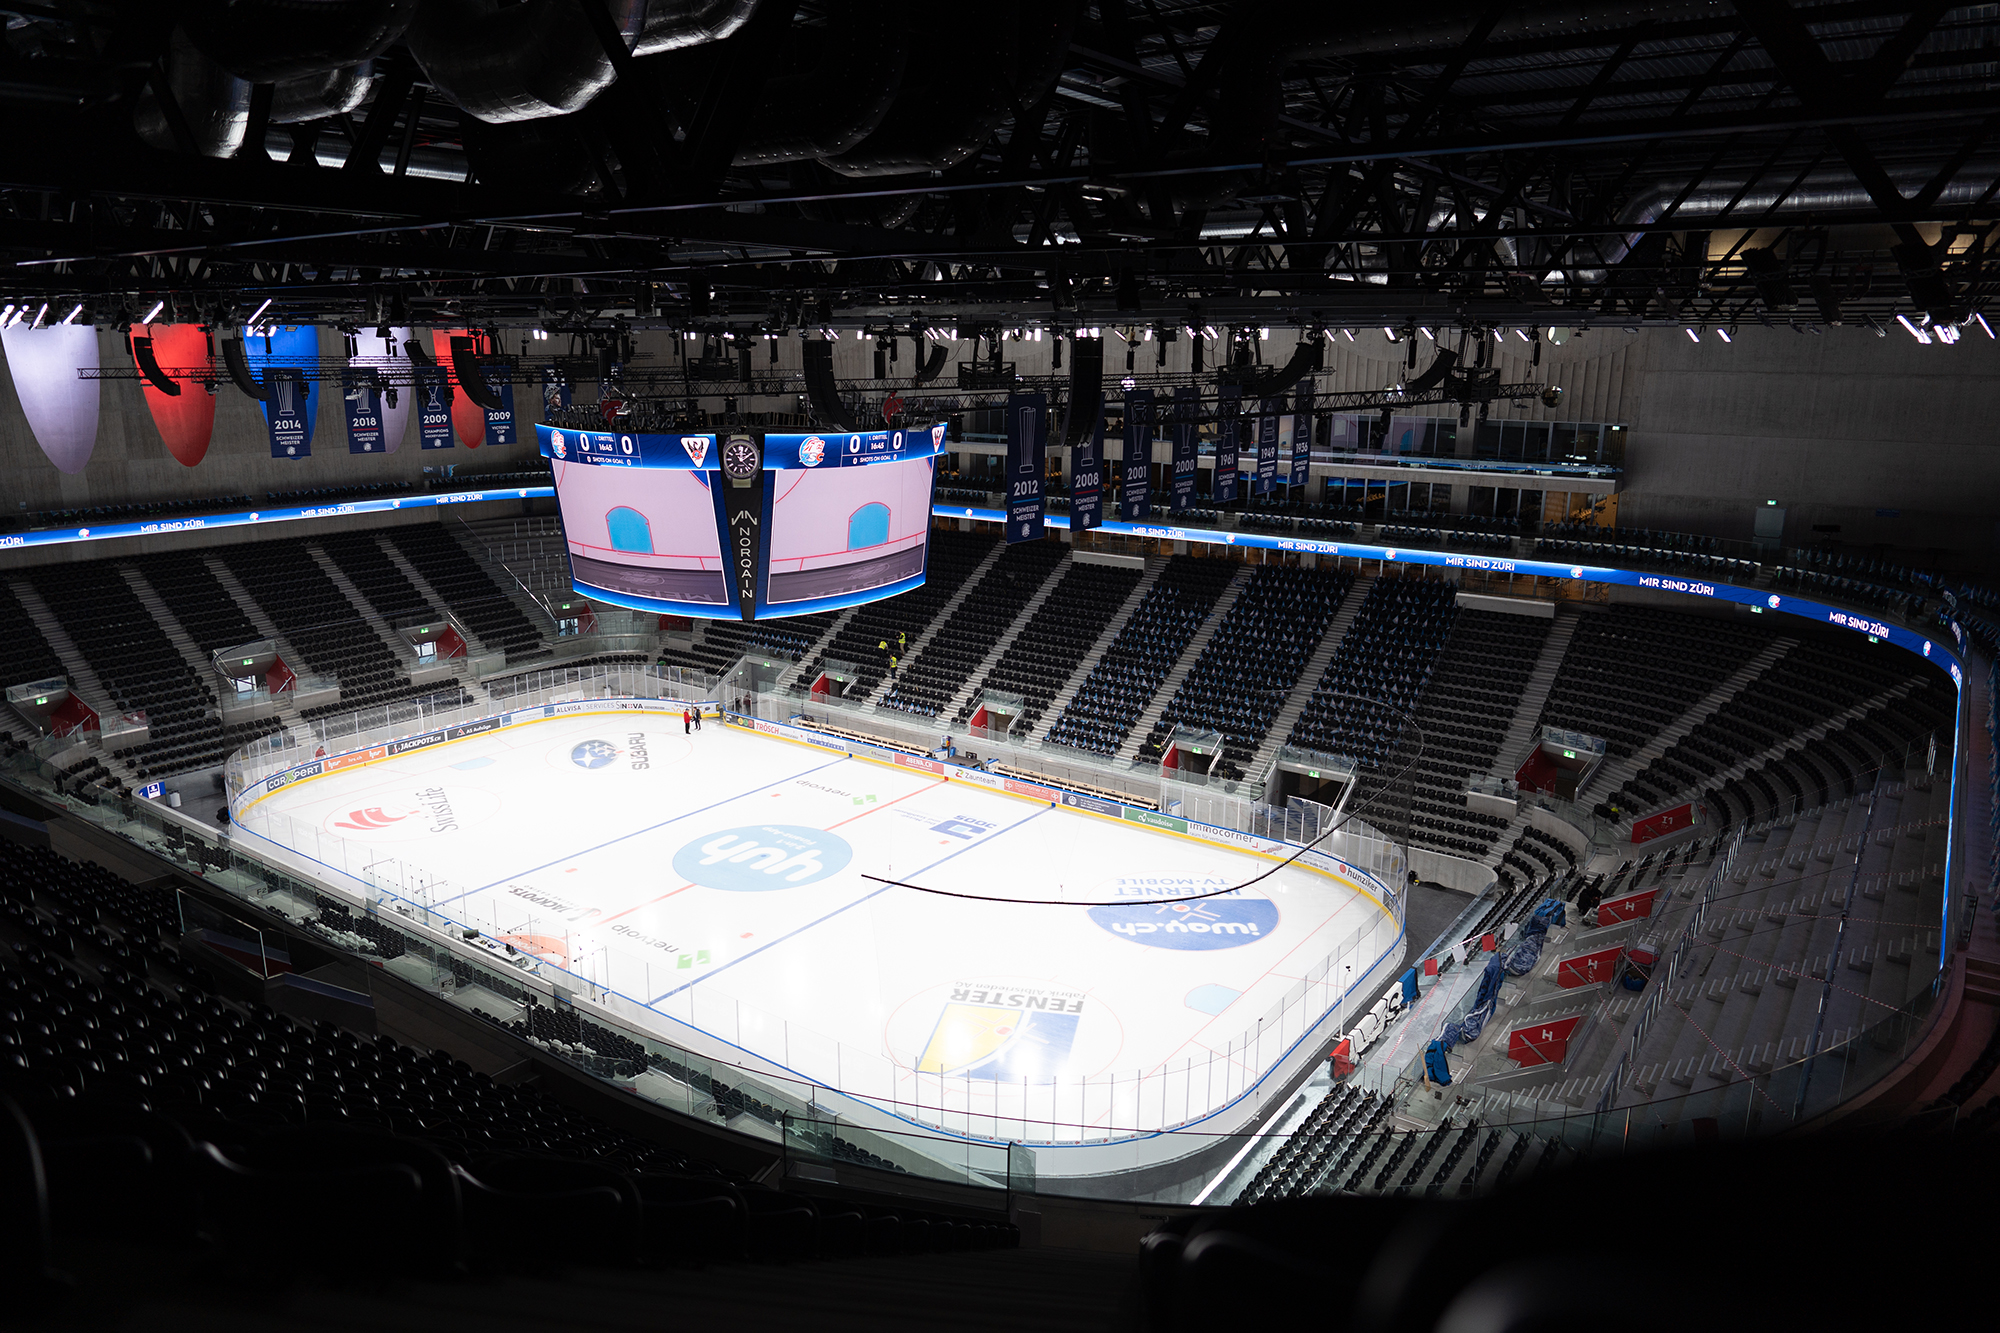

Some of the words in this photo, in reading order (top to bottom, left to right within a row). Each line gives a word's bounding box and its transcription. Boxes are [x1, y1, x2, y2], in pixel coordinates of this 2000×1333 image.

[352, 417, 376, 427] 2018
[423, 414, 447, 424] 2009
[488, 411, 511, 421] 2009
[274, 420, 301, 430] 2014
[580, 433, 589, 451] 0
[621, 435, 633, 454] 0
[850, 434, 860, 453] 0
[893, 432, 902, 450] 0
[1296, 442, 1308, 453] 1936
[1220, 453, 1234, 466] 1961
[1261, 447, 1275, 459] 1949
[1175, 459, 1194, 473] 2000
[1127, 466, 1146, 480] 2001
[1075, 472, 1099, 488] 2008
[1014, 480, 1038, 496] 2012
[1013, 505, 1039, 514] SCHWEIZER
[1016, 513, 1035, 521] MEISTER
[140, 524, 159, 533] MIR
[161, 522, 182, 531] SIND
[184, 519, 205, 528] ZÜRI
[1148, 528, 1166, 536] SIND
[1167, 529, 1185, 538] ZÜRI
[0, 536, 24, 546] ZÜRI
[1278, 541, 1294, 550] MIR
[1296, 542, 1316, 552] SIND
[1317, 543, 1338, 554] ZÜRI
[740, 527, 752, 598] NORQAIN
[1445, 557, 1464, 566] MIR
[1466, 558, 1490, 568] SIND
[1491, 559, 1515, 571] ZÜRI
[1639, 576, 1660, 587] MIR
[1662, 579, 1687, 592] SIND
[1689, 582, 1714, 596] ZÜRI
[1829, 612, 1846, 625] MIR
[1847, 617, 1869, 632] SIND
[1869, 620, 1889, 638] ZÜRI
[556, 705, 581, 713] ALLVISA
[756, 722, 779, 734] TRÖSCH
[627, 732, 650, 770] SUBARU
[965, 773, 996, 785] Zaunteam
[796, 779, 851, 797] netvoip
[1147, 818, 1173, 828] vaudoise
[762, 827, 817, 845] Finanz-App
[1190, 822, 1253, 843] immocorner
[699, 835, 823, 882] yuh
[1347, 868, 1377, 892] hunziker
[1115, 888, 1241, 896] INTERNET
[1625, 902, 1635, 911] H
[1112, 920, 1260, 936] iway.ch
[611, 924, 679, 954] netvoip
[1588, 959, 1598, 969] H
[442, 979, 454, 988] F3
[976, 983, 1045, 995] Albisrieden
[950, 988, 1084, 1013] FENSTER
[1050, 991, 1086, 999] Fabrik
[1542, 1029, 1553, 1041] H
